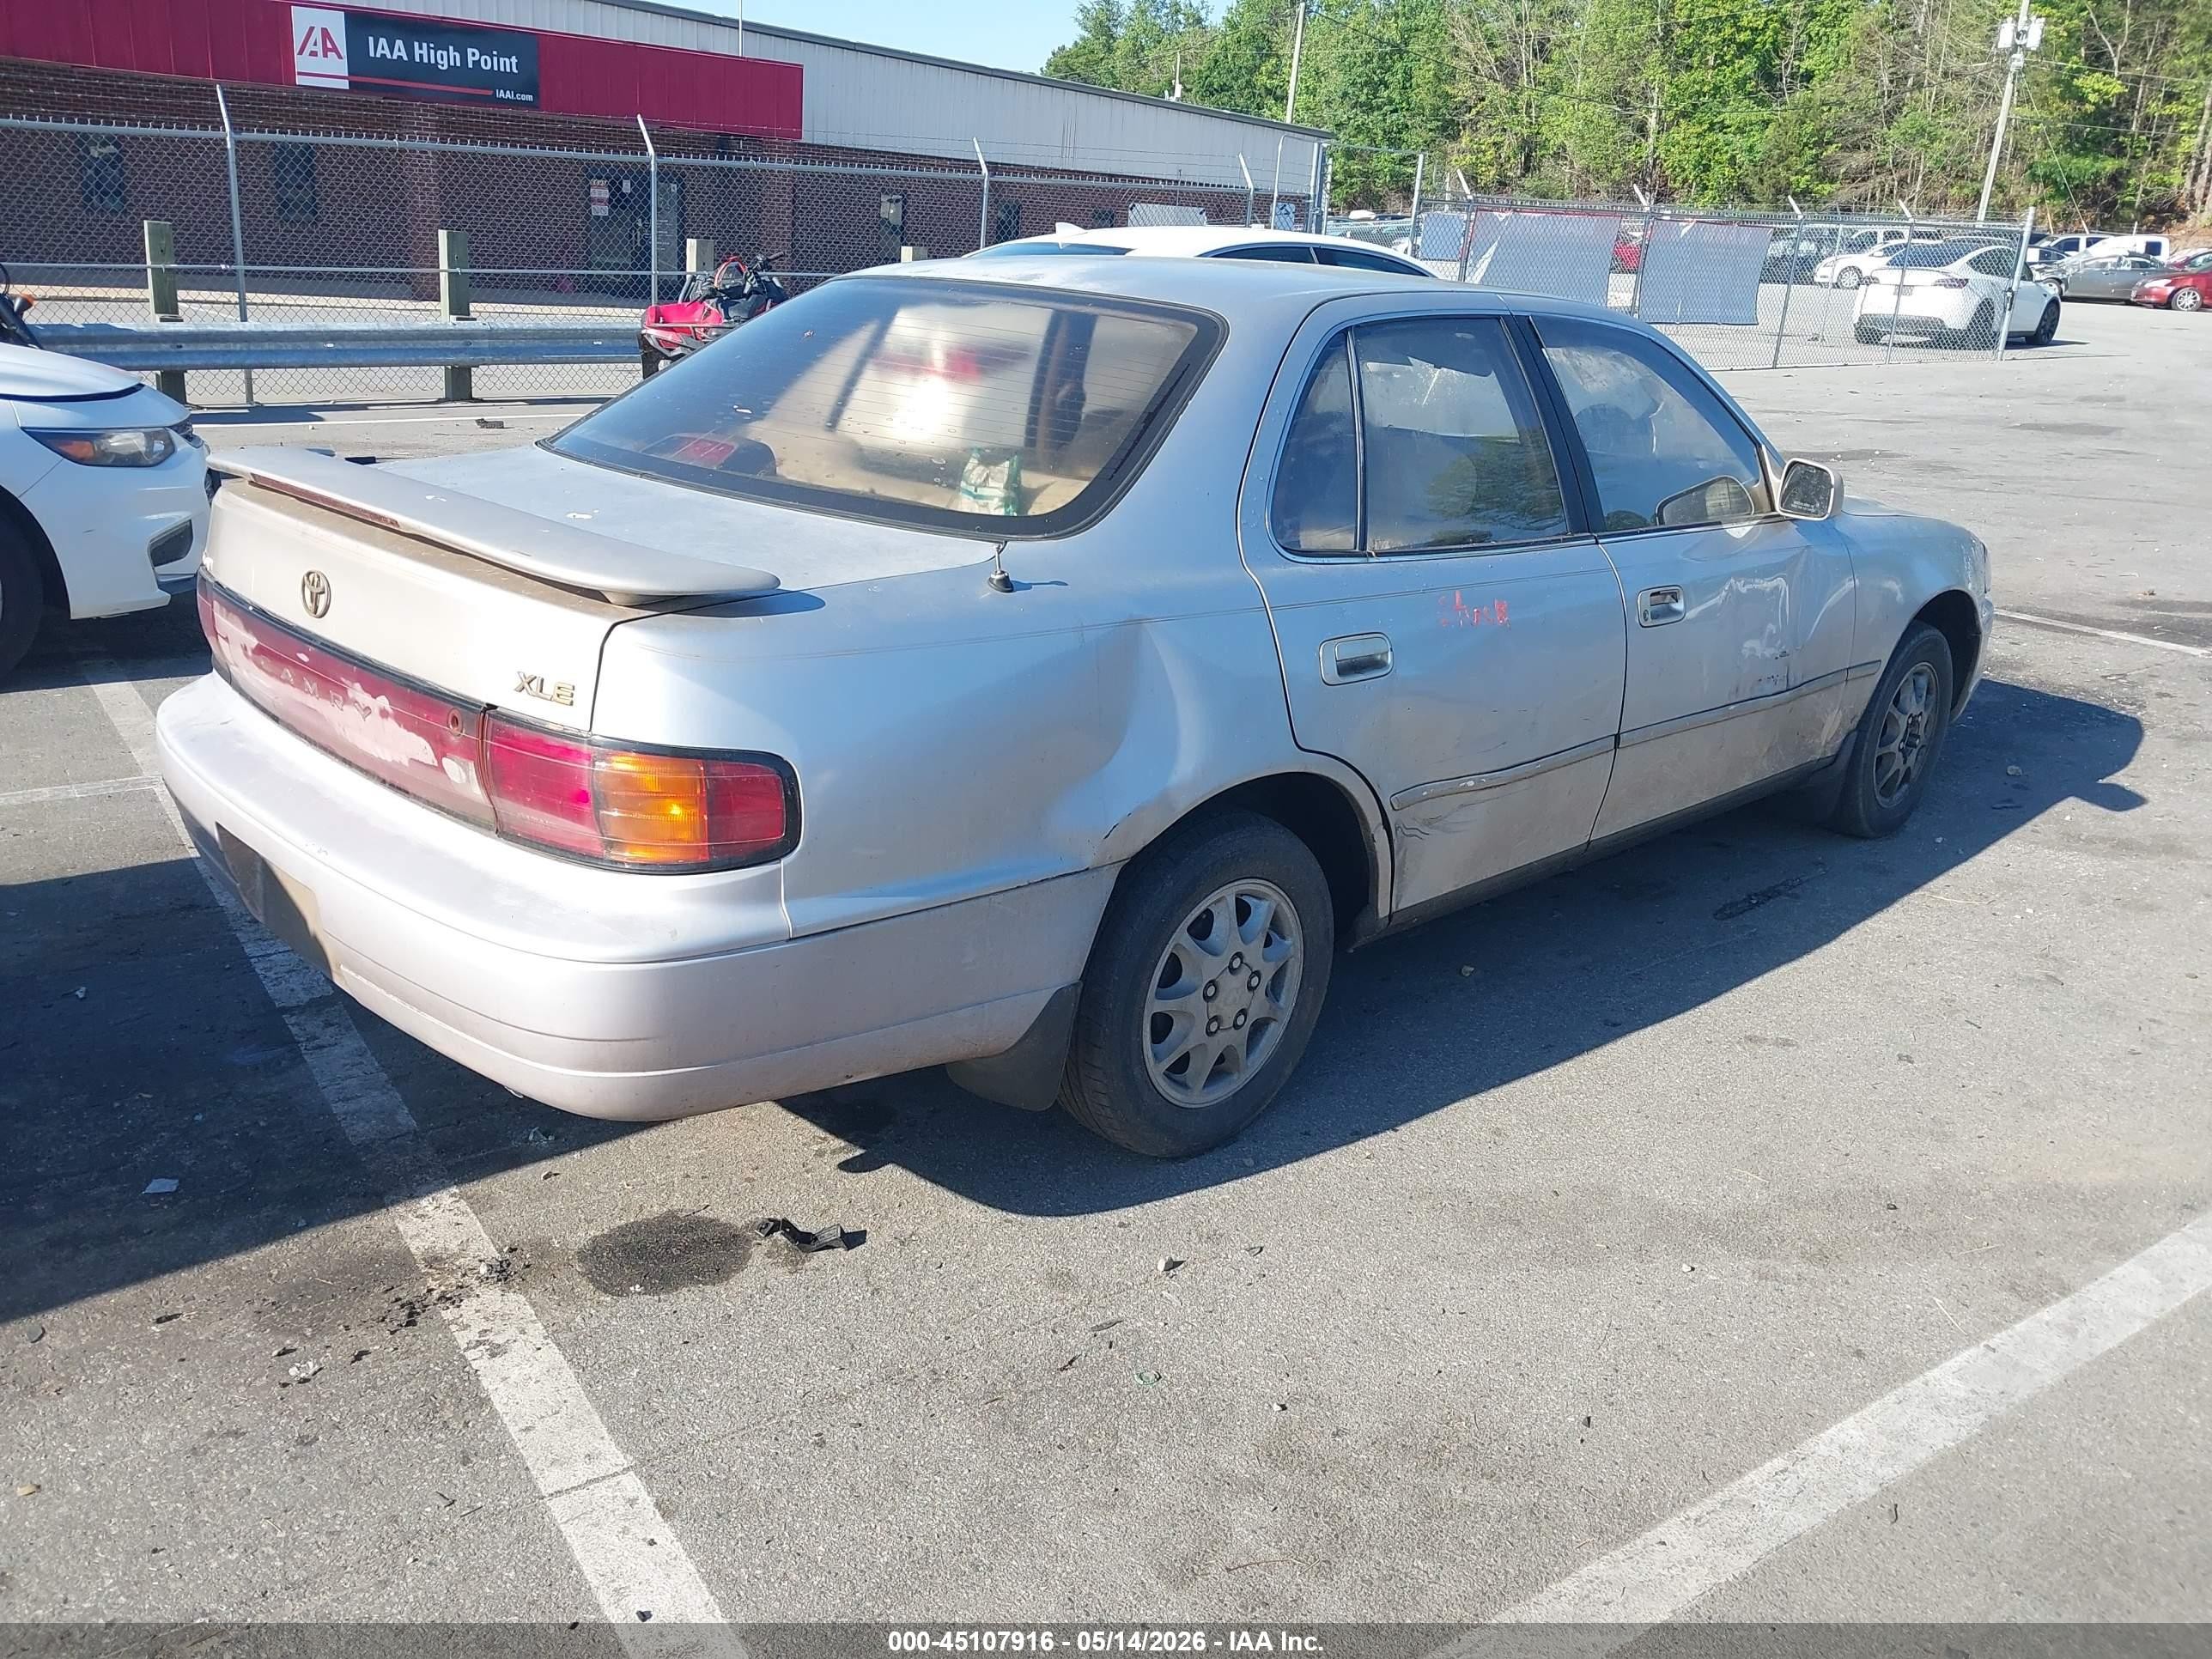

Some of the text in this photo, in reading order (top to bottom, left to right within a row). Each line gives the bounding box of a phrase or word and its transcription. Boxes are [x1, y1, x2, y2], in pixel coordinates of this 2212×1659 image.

[368, 36, 519, 74] IAA High Point
[495, 88, 534, 102] IAAI.com
[514, 671, 575, 706] XLE
